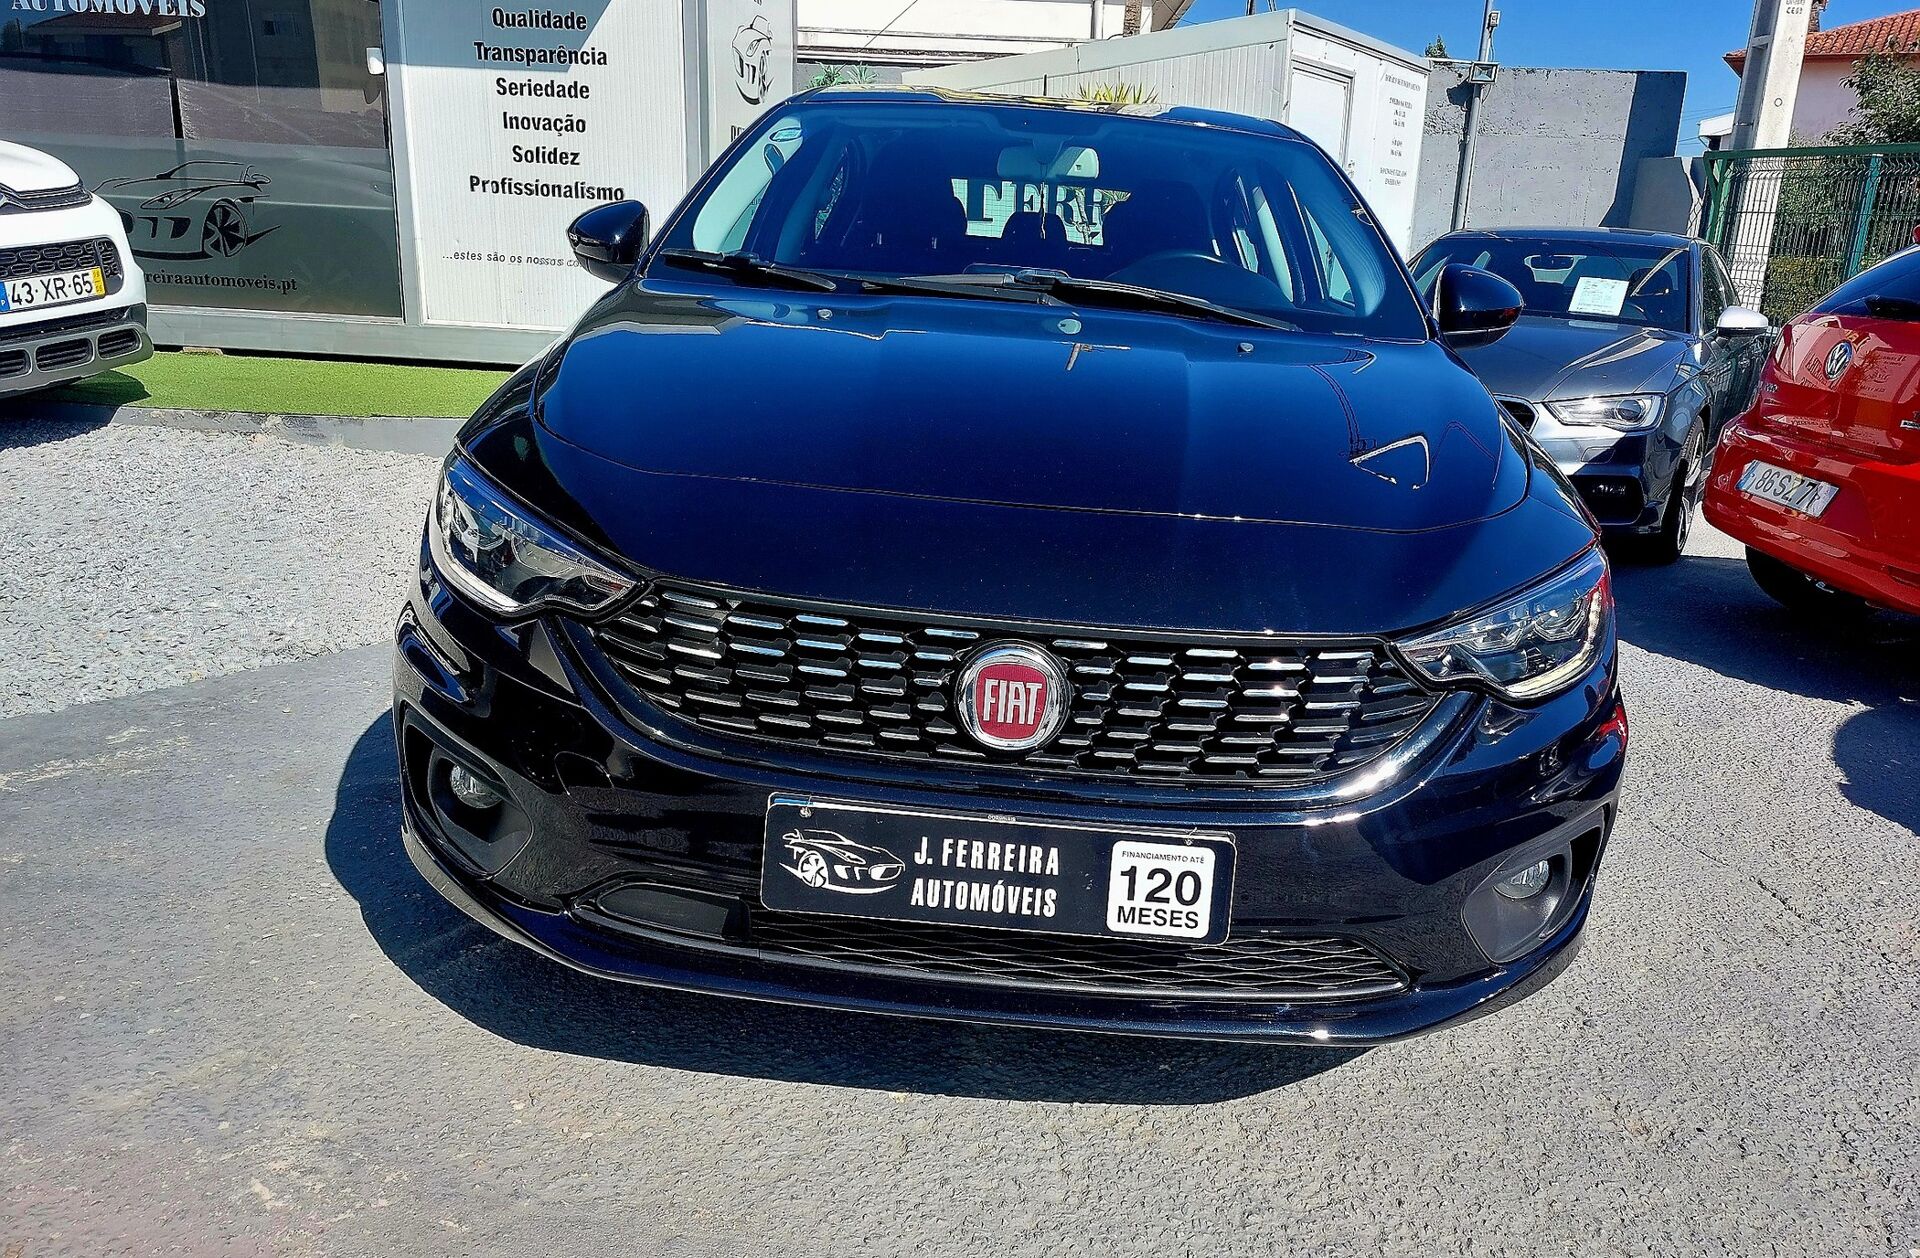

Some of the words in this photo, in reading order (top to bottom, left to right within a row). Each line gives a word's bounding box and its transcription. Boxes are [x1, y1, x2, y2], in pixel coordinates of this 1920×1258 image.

[492, 8, 587, 30] Qualidade
[474, 42, 607, 66] Transparência
[496, 77, 590, 99] Seriedade
[503, 111, 586, 136] Inovação
[512, 145, 580, 165] Solidez
[469, 175, 625, 201] Profissionalismo
[486, 251, 506, 263] são
[509, 254, 523, 264] os
[983, 678, 1042, 725] FIAT
[914, 836, 933, 865] J.
[941, 838, 1060, 876] FERREIRA
[1122, 850, 1188, 863] FINANCIAMENTO
[1120, 865, 1202, 906] 120
[910, 879, 1058, 918] AUTOMÓVEIS
[1117, 905, 1200, 929] MESES
